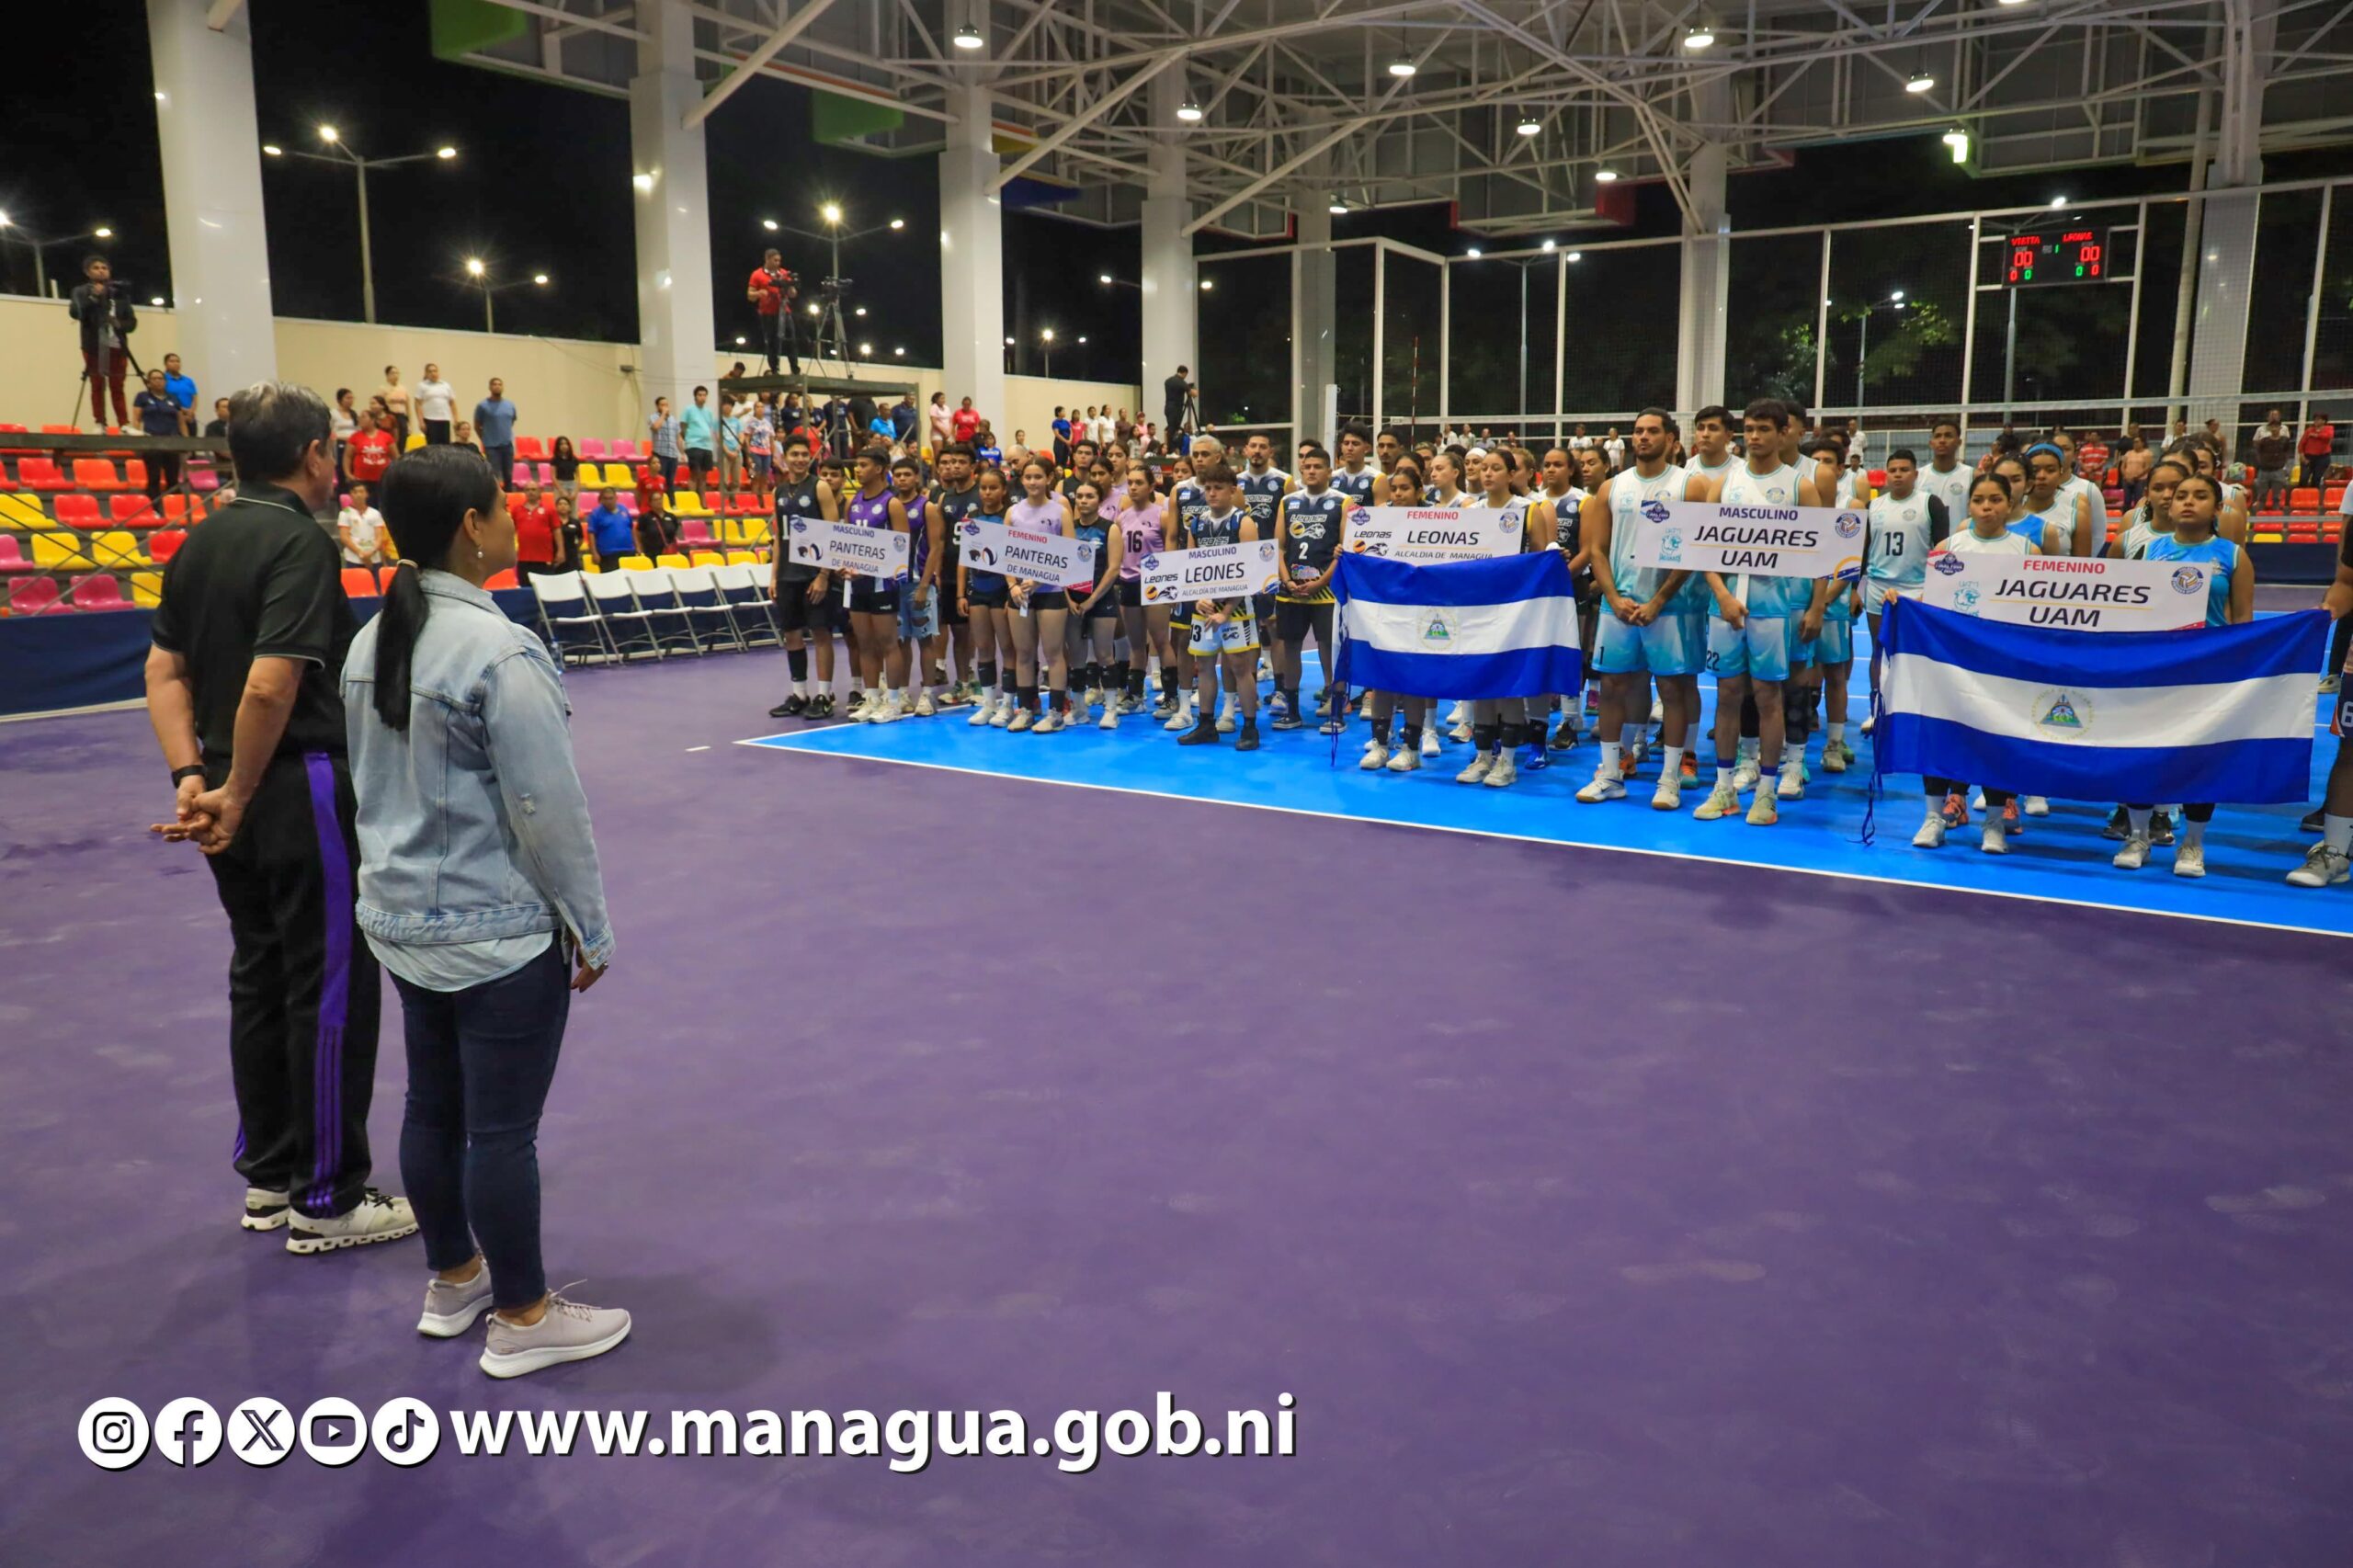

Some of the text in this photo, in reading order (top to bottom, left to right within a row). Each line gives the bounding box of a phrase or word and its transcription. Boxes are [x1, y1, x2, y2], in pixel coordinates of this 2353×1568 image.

[2014, 251, 2032, 266] 00
[2080, 245, 2100, 262] 00
[2010, 270, 2018, 281] 0
[2024, 268, 2031, 279] 0
[2075, 266, 2083, 276] 0
[2091, 264, 2099, 276] 0
[1406, 510, 1460, 521] FEMENINO
[1719, 506, 1799, 521] MASCULINO
[833, 524, 875, 539] MASCULINO
[1008, 529, 1048, 544] FEMENINO
[1353, 530, 1392, 539] Leonas
[1406, 530, 1480, 546] LEONAS
[1694, 526, 1820, 548] JAGUARES
[1126, 529, 1143, 553] 16
[1884, 531, 1904, 557] 13
[829, 540, 886, 561] PANTERAS
[1005, 545, 1069, 569] PANTERAS
[1188, 546, 1237, 560] MASCULINO
[1298, 542, 1309, 560] 2
[1449, 552, 1494, 561] MANAGUA
[832, 558, 879, 574] DE MANAGUA
[1721, 550, 1779, 569] UAM
[2023, 559, 2106, 574] FEMENINO
[1006, 563, 1061, 583] DE MANAGUA
[1144, 573, 1178, 585] Leones
[1185, 562, 1245, 584] LEONES
[1218, 584, 1248, 593] MANAGUA
[1995, 579, 2151, 605] JAGUARES
[2029, 606, 2101, 627] UAM
[1599, 646, 1605, 665] 1
